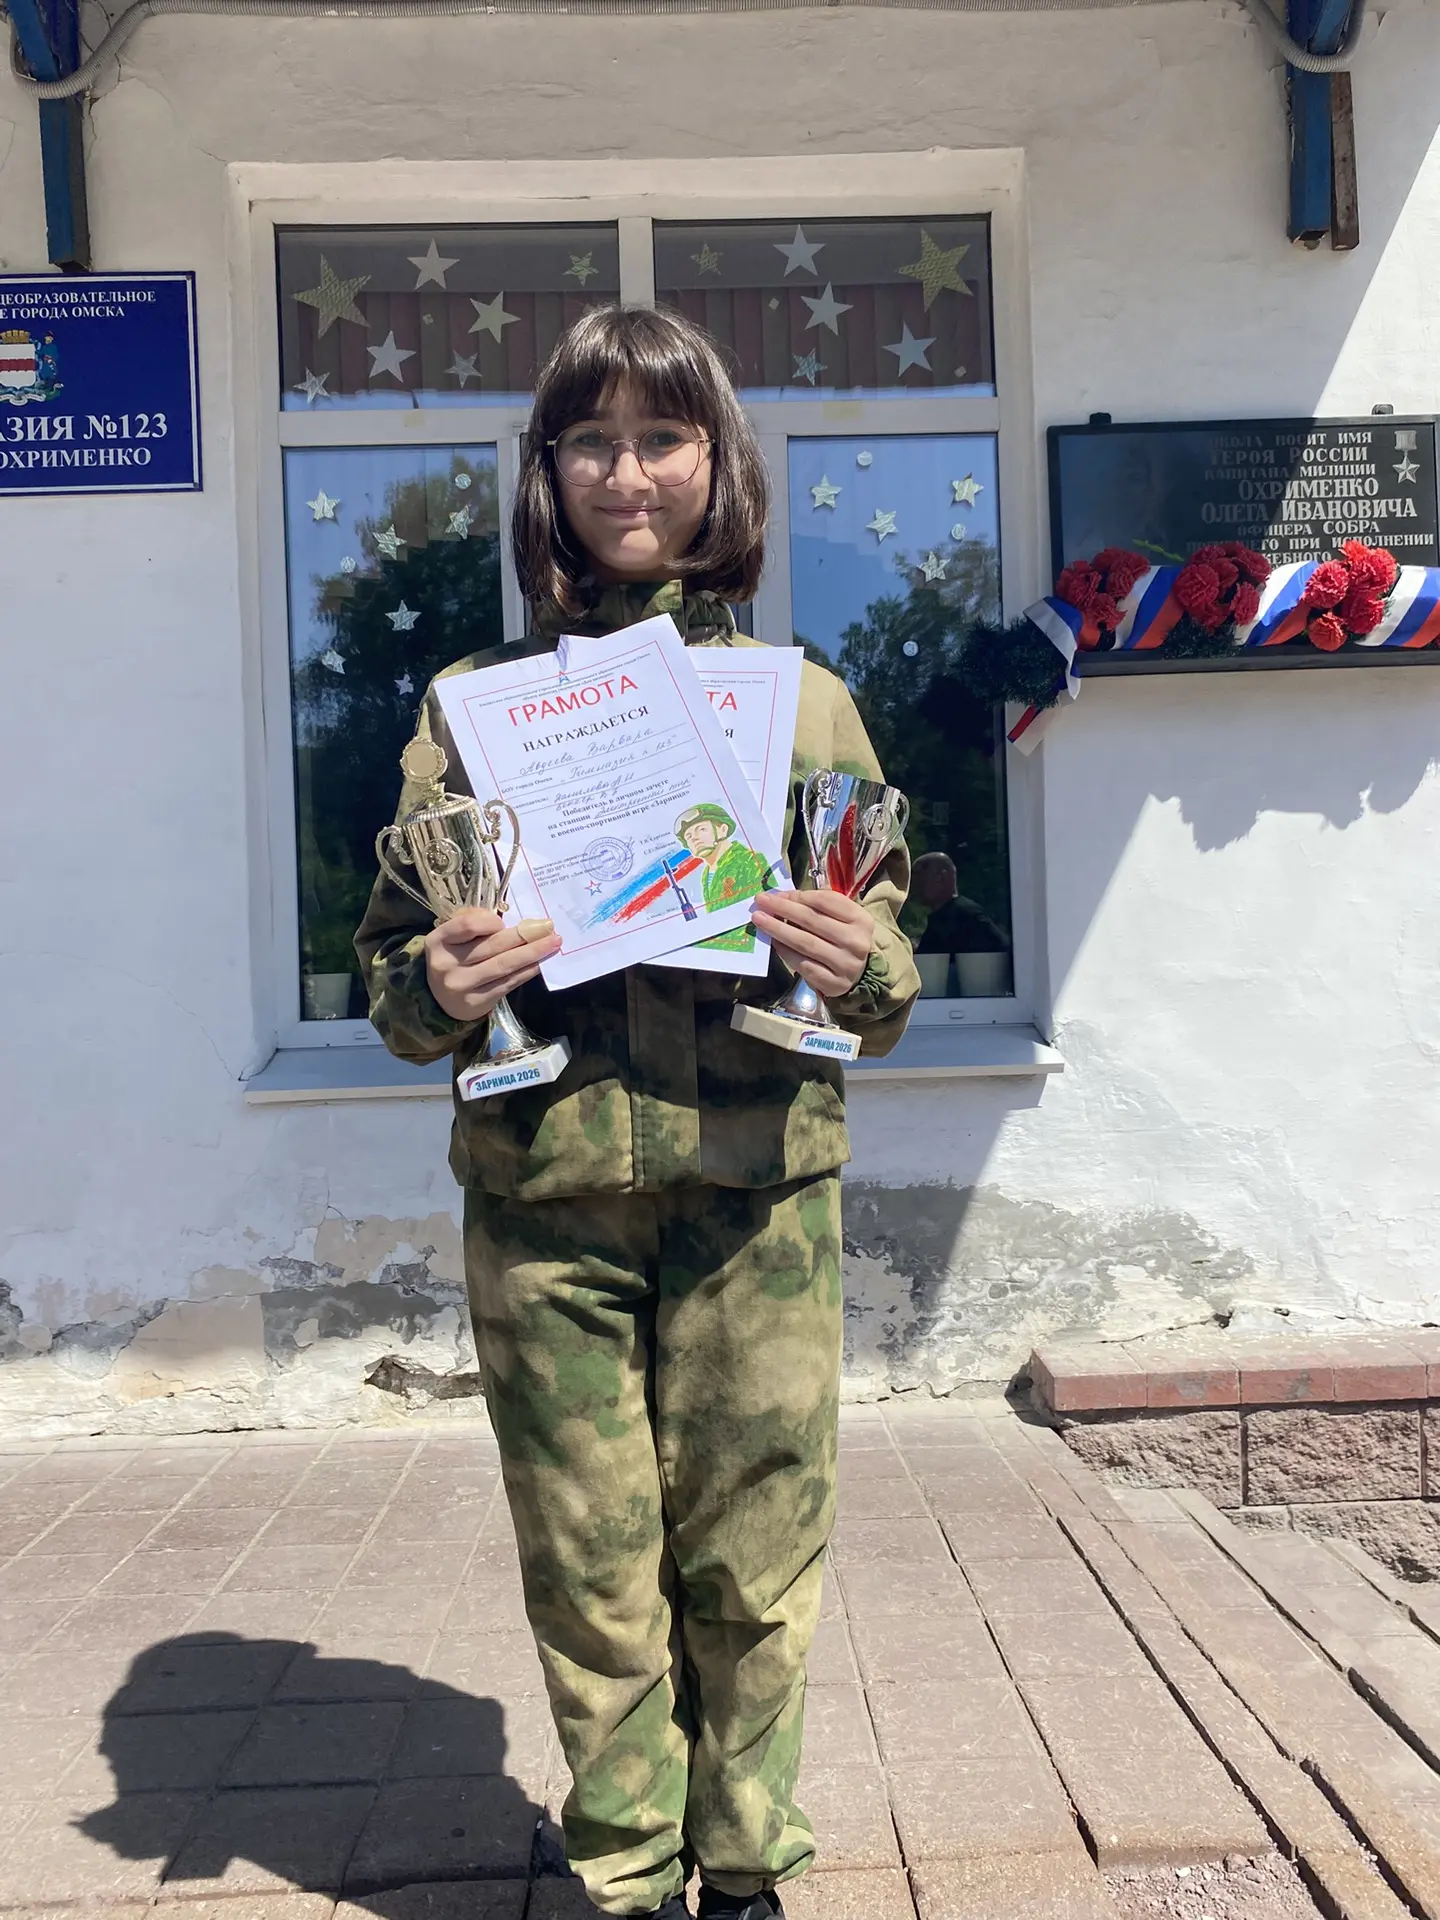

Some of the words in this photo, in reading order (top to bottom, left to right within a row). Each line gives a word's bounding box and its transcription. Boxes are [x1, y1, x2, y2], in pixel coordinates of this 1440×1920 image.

[11, 307, 69, 320] ГОРОДА
[71, 305, 125, 318] ОМСКА
[83, 413, 168, 439] №123
[1338, 431, 1372, 444] ИМЯ
[1210, 448, 1276, 465] ГЕРОЯ
[1289, 447, 1368, 465] РОССИИ
[1300, 463, 1376, 478] МИЛИЦИИ
[1238, 477, 1379, 500] ОХРИМЕНКО
[1201, 502, 1269, 524] ОЛЕГА
[1281, 498, 1418, 521] ИВАНОВИЧА
[1237, 522, 1313, 538] ОФИЦЕРА
[1322, 520, 1381, 535] СОБРА
[1288, 537, 1320, 550] ПРИ
[507, 674, 639, 727] ГРАМОТА
[522, 705, 650, 752] НАГРАЖДАЕТСЯ
[562, 799, 608, 817] Победитель
[615, 788, 646, 802] личном
[645, 778, 669, 792] зачете
[556, 811, 632, 837] военно-спортивной
[632, 804, 650, 816] игре
[650, 790, 691, 809] «Зарница»
[558, 813, 591, 828] станции
[805, 1037, 835, 1051] ЗАРНИЦА
[834, 1041, 852, 1053] 2026
[475, 1075, 517, 1091] ЗАРНИЦА
[516, 1068, 540, 1082] 2026
